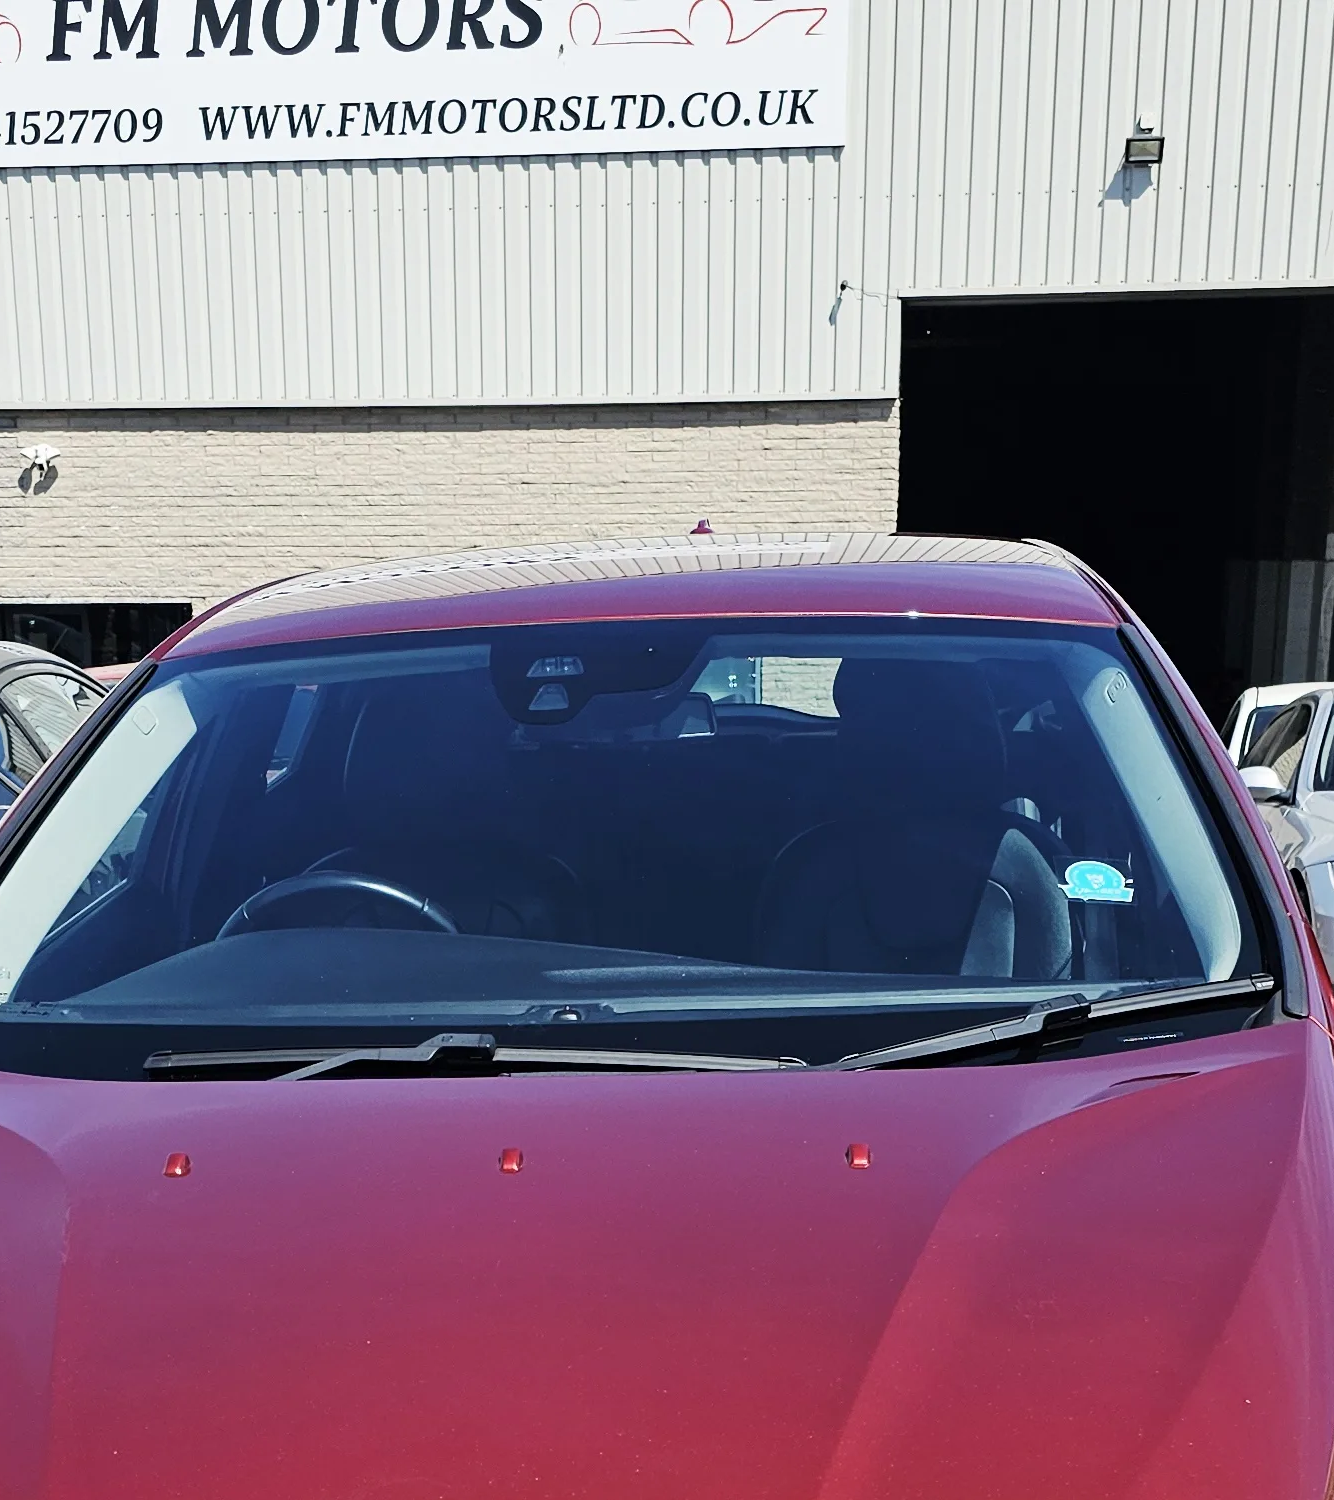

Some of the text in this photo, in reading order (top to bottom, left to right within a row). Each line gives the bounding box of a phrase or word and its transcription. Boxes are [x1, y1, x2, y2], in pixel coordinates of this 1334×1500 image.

[46, 0, 544, 61] FM MOTORS
[198, 88, 820, 141] WWW.FMMOTORSLTD.CO.UK
